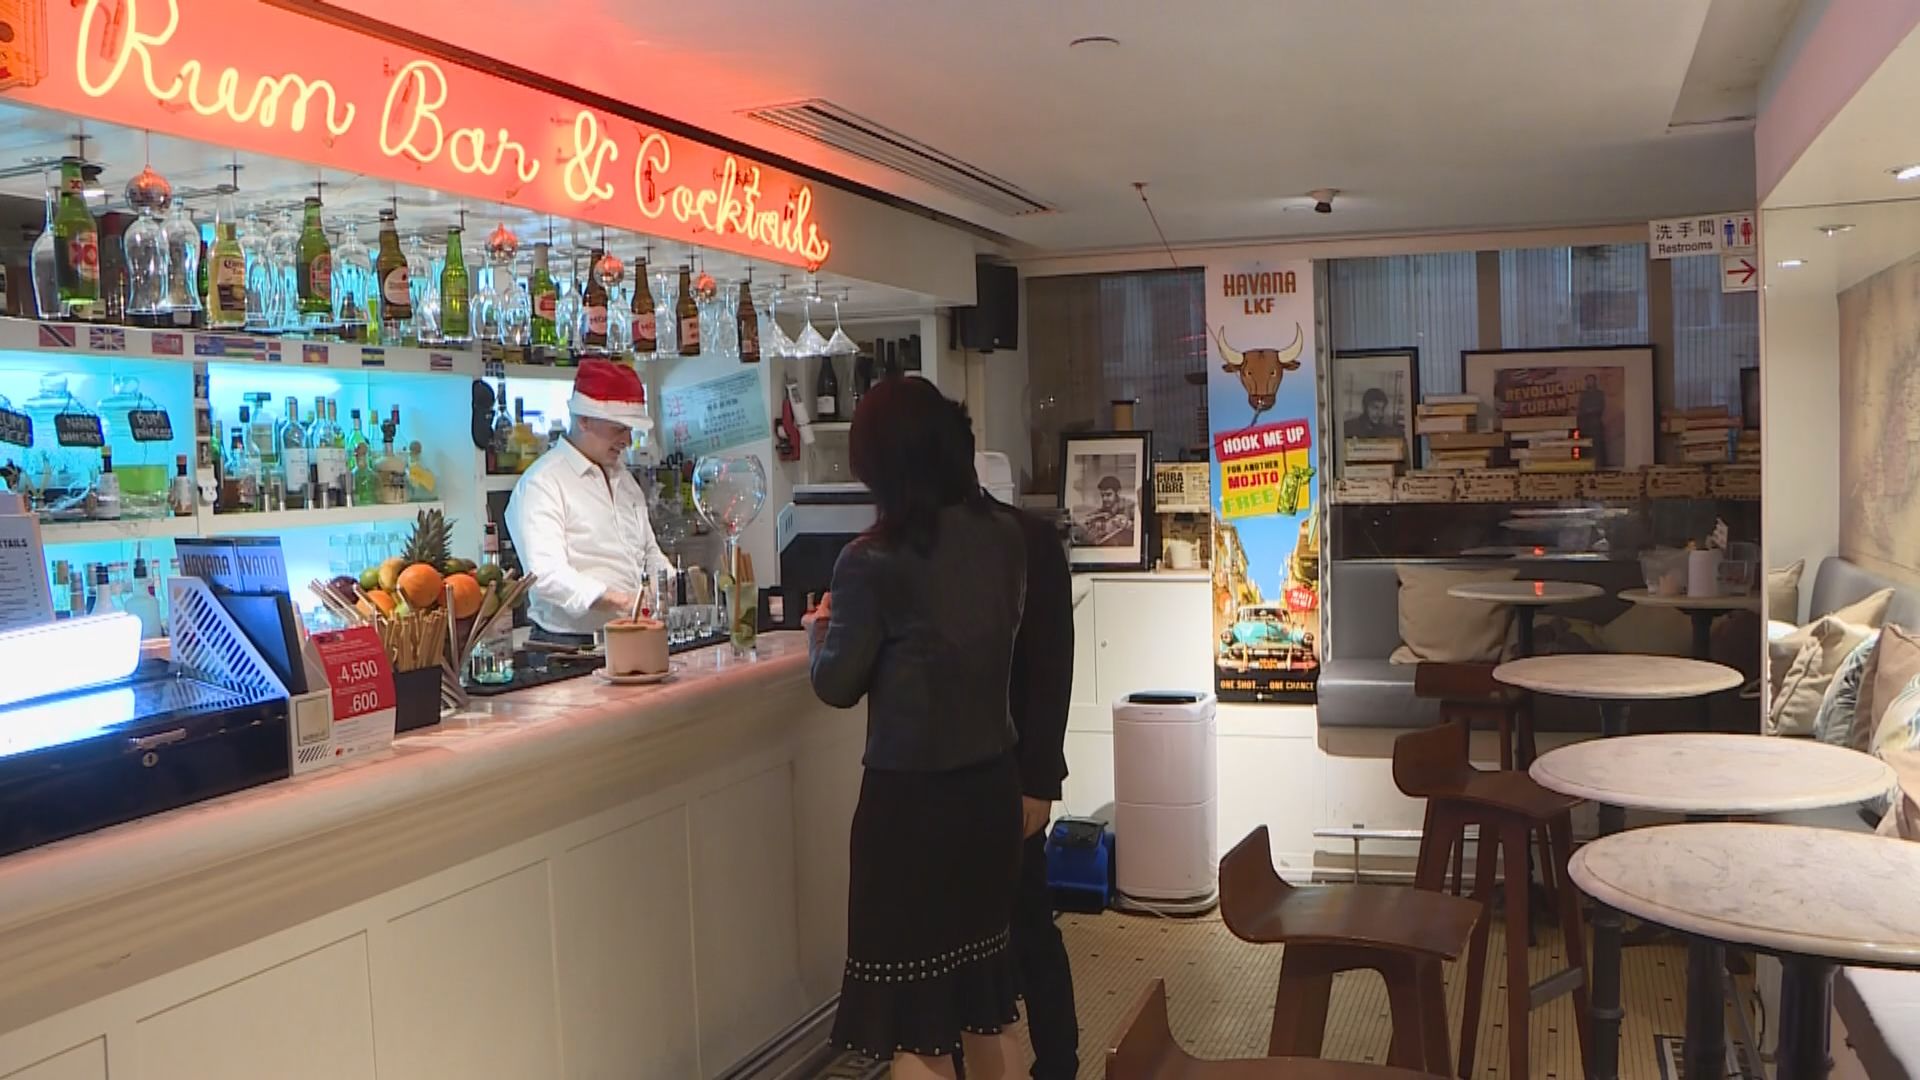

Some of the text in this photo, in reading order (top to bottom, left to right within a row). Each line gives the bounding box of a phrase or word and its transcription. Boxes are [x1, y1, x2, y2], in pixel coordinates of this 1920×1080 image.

[76, 0, 831, 261] Rum Bar & Cocktails
[1656, 219, 1715, 240] 洗手間
[1658, 242, 1713, 254] Restrooms
[1223, 271, 1297, 297] HAVANA
[1244, 297, 1275, 315] LKF
[1223, 426, 1305, 454] HOOK ME UP
[1156, 472, 1184, 482] CUBA
[1227, 460, 1279, 474] FOR ANOTHER
[1157, 481, 1185, 493] LIBRE
[1228, 470, 1279, 489] MOJITO
[1224, 489, 1274, 513] FREE
[183, 554, 231, 576] HAVANA
[341, 660, 378, 683] 4,500
[1220, 680, 1235, 690] ONE
[1269, 681, 1284, 691] ONE
[1286, 681, 1314, 690] CHANCE
[352, 690, 378, 712] 600
